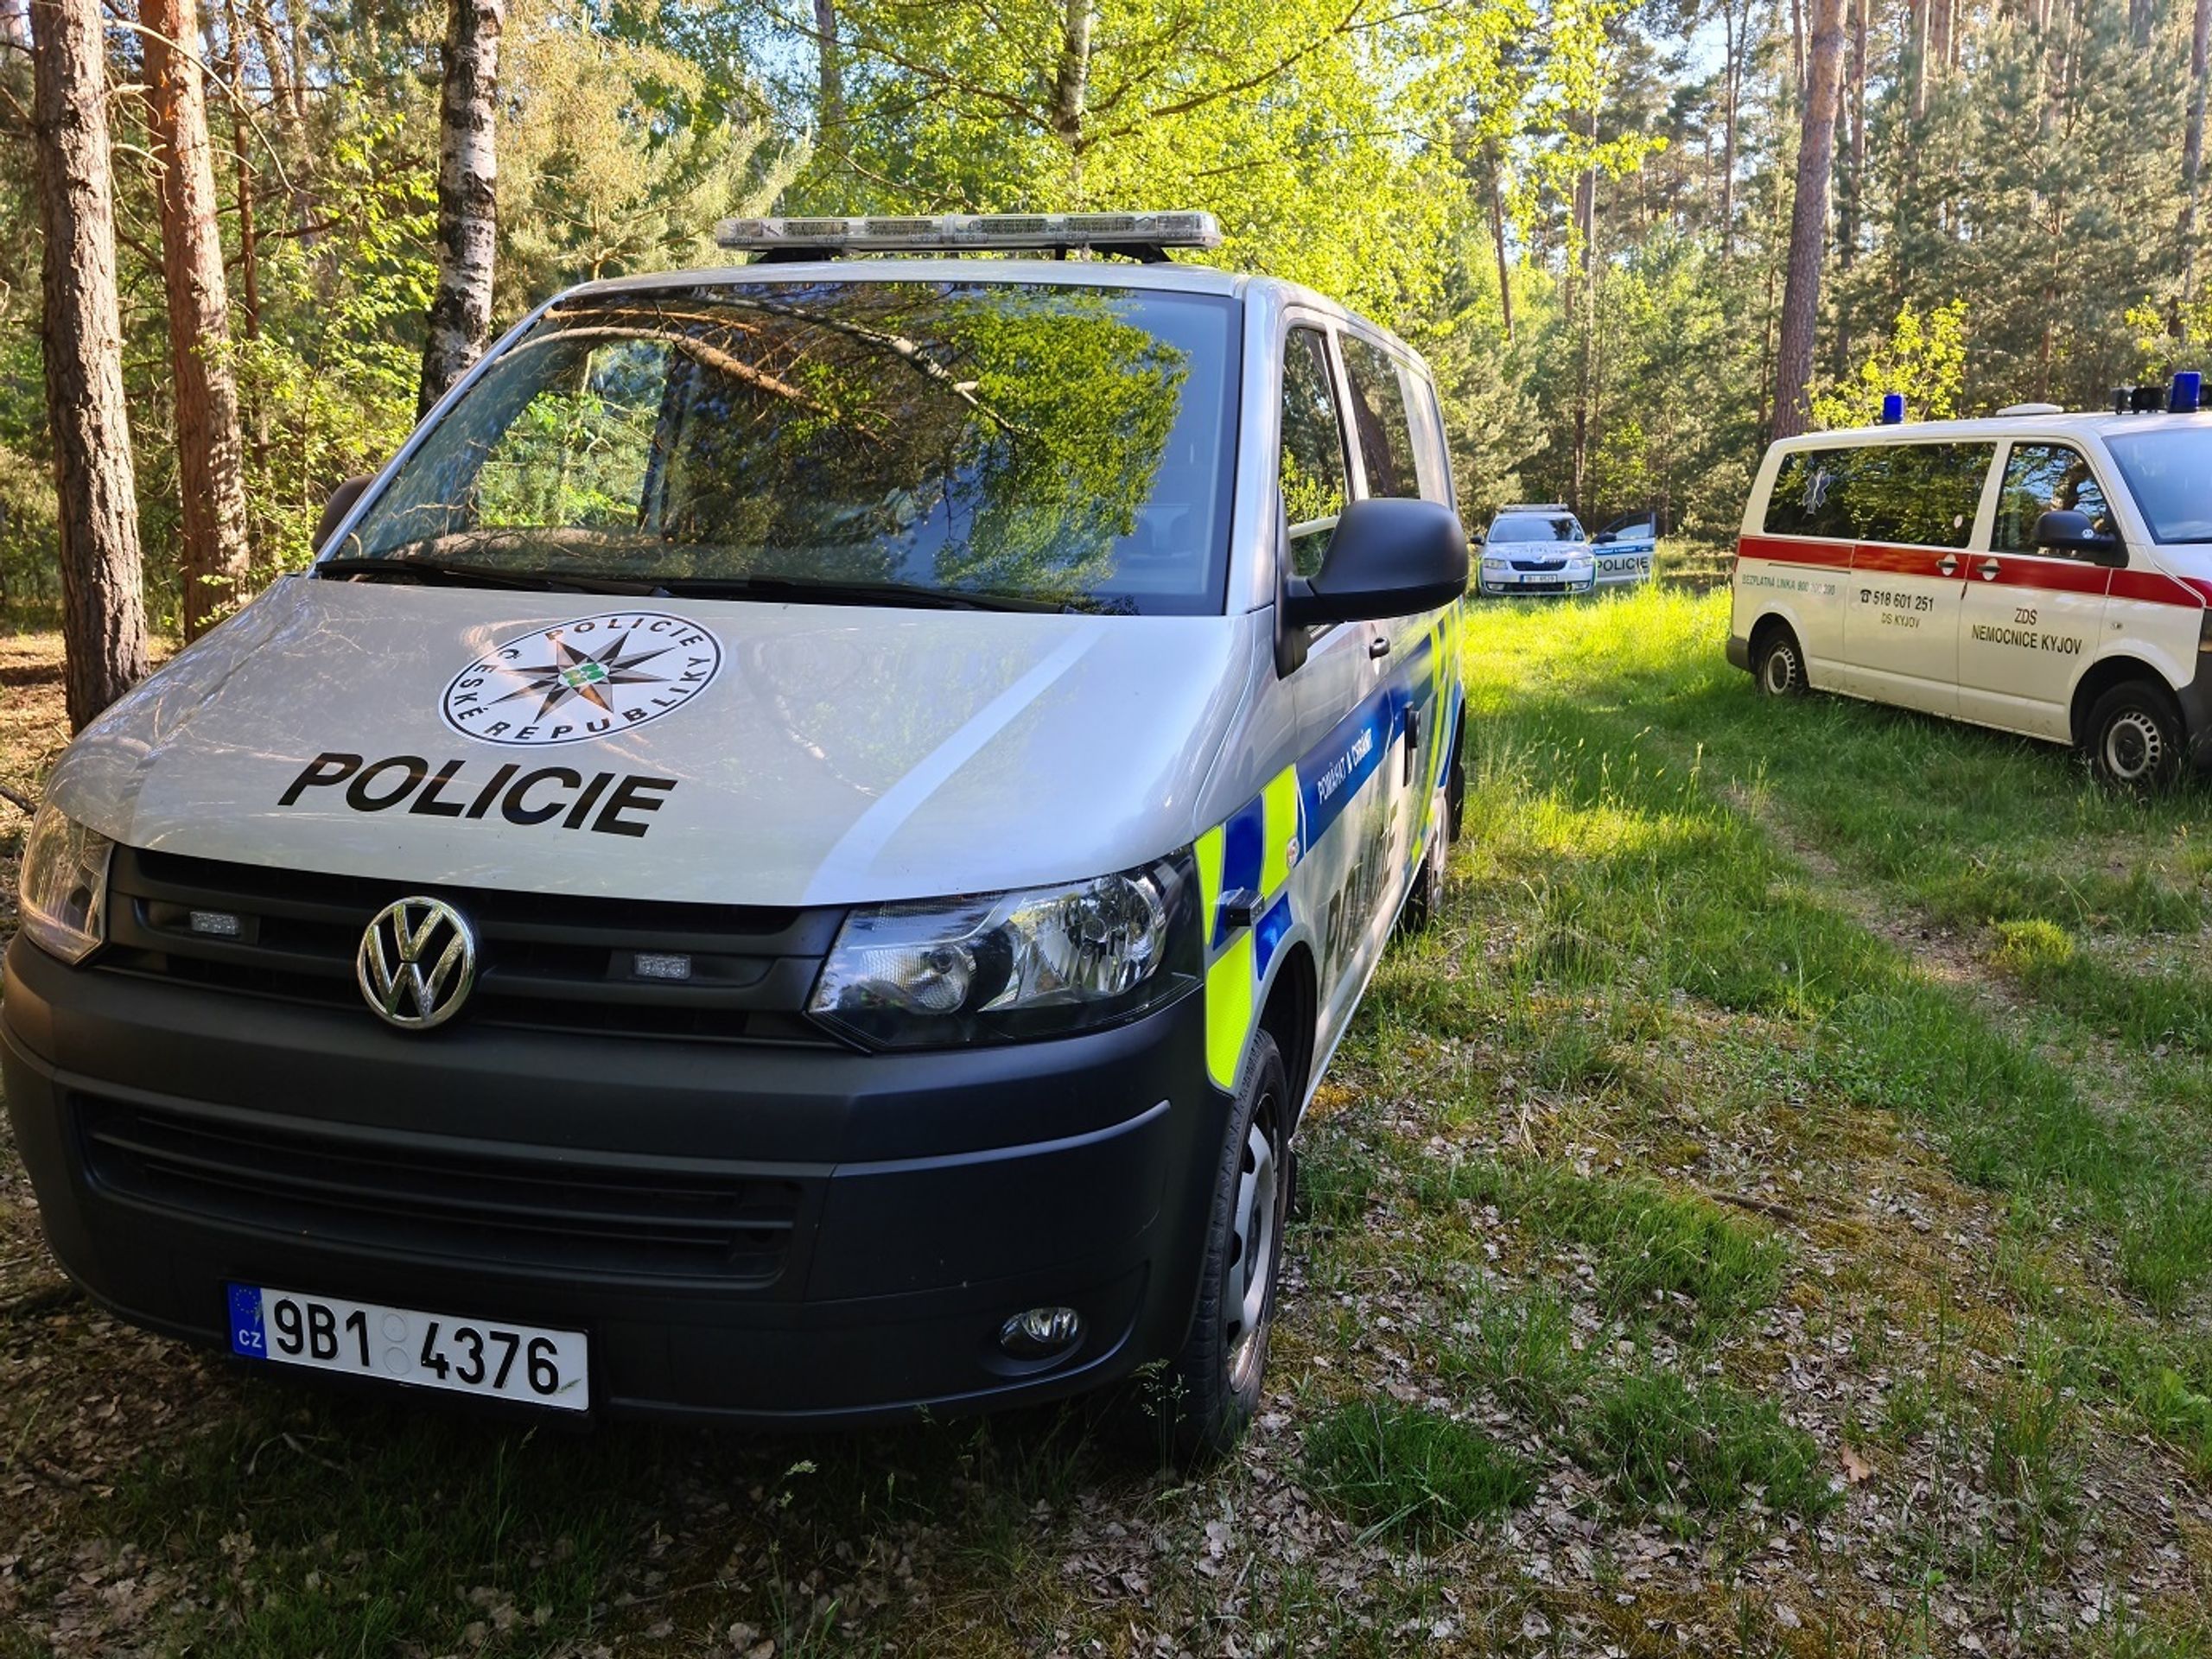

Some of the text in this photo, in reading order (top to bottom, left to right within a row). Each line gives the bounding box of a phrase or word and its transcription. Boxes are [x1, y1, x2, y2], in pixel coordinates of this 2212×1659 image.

[1597, 556, 1649, 571] POLICIE
[1873, 590, 1934, 612] 518 601 251
[1894, 613, 1920, 628] KYJOV
[2014, 607, 2037, 626] ZDS
[545, 617, 704, 648] POLICIE
[1972, 624, 2082, 655] NEMOCNICE KYJOV
[454, 648, 711, 741] ČESKÉ REPUBLIKY
[276, 752, 678, 838] POLICIE
[238, 1329, 263, 1349] CZ
[274, 1299, 560, 1395] 9B1 4376
